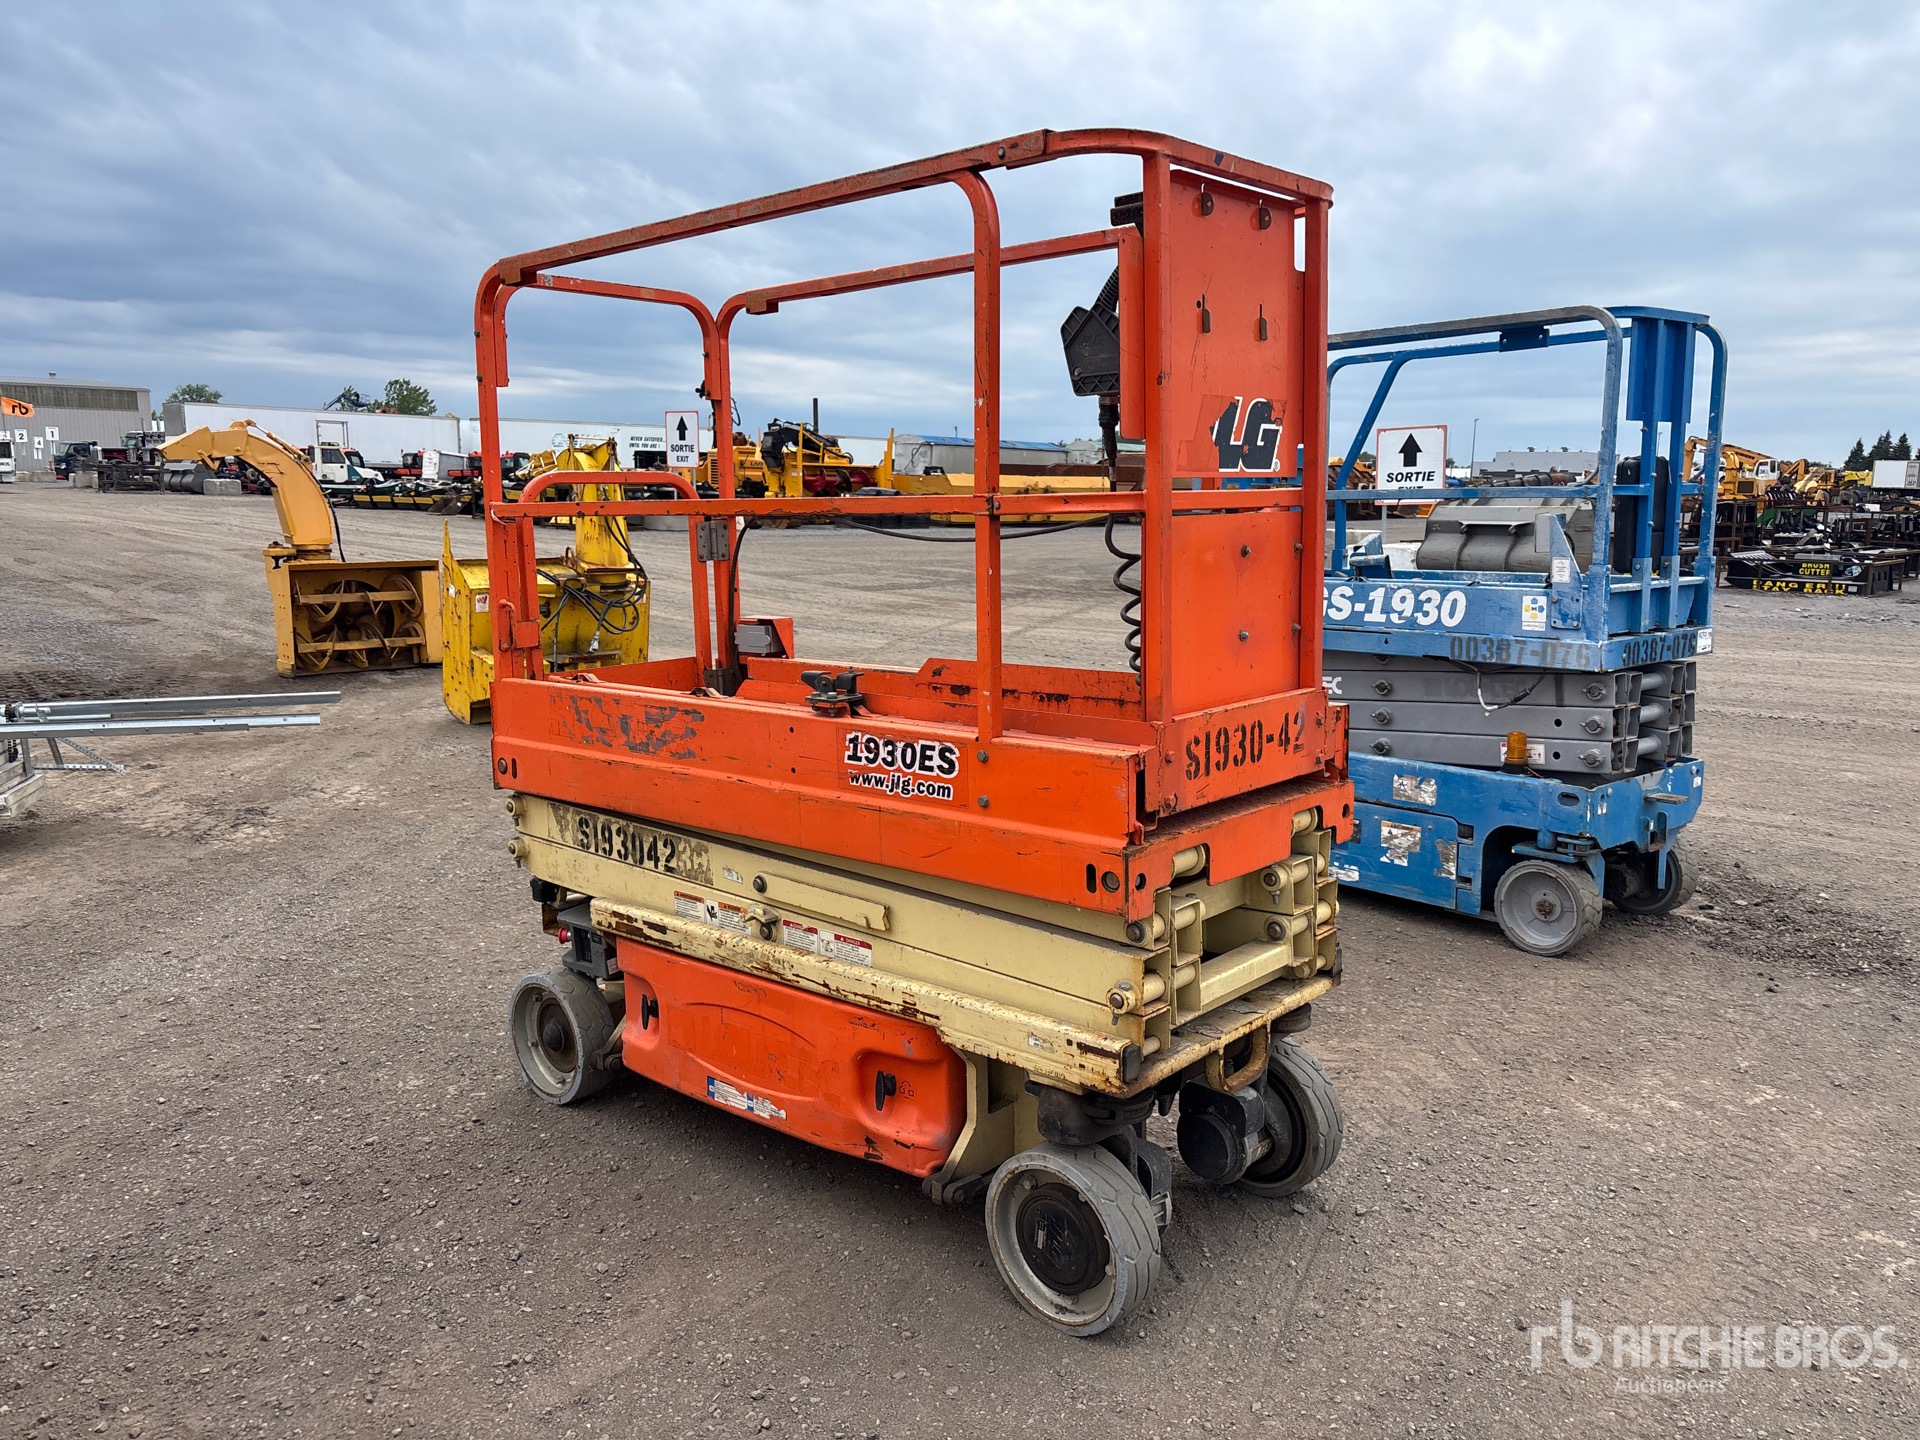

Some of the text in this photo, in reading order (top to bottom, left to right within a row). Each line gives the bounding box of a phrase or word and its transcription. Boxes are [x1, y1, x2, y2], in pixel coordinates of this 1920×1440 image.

[670, 444, 695, 453] SORTIE
[676, 455, 690, 463] EXIT
[1385, 470, 1436, 483] SORTIE
[1323, 585, 1467, 628] S-1930
[845, 732, 959, 777] 1930ES
[848, 770, 953, 800] www.jlg.com
